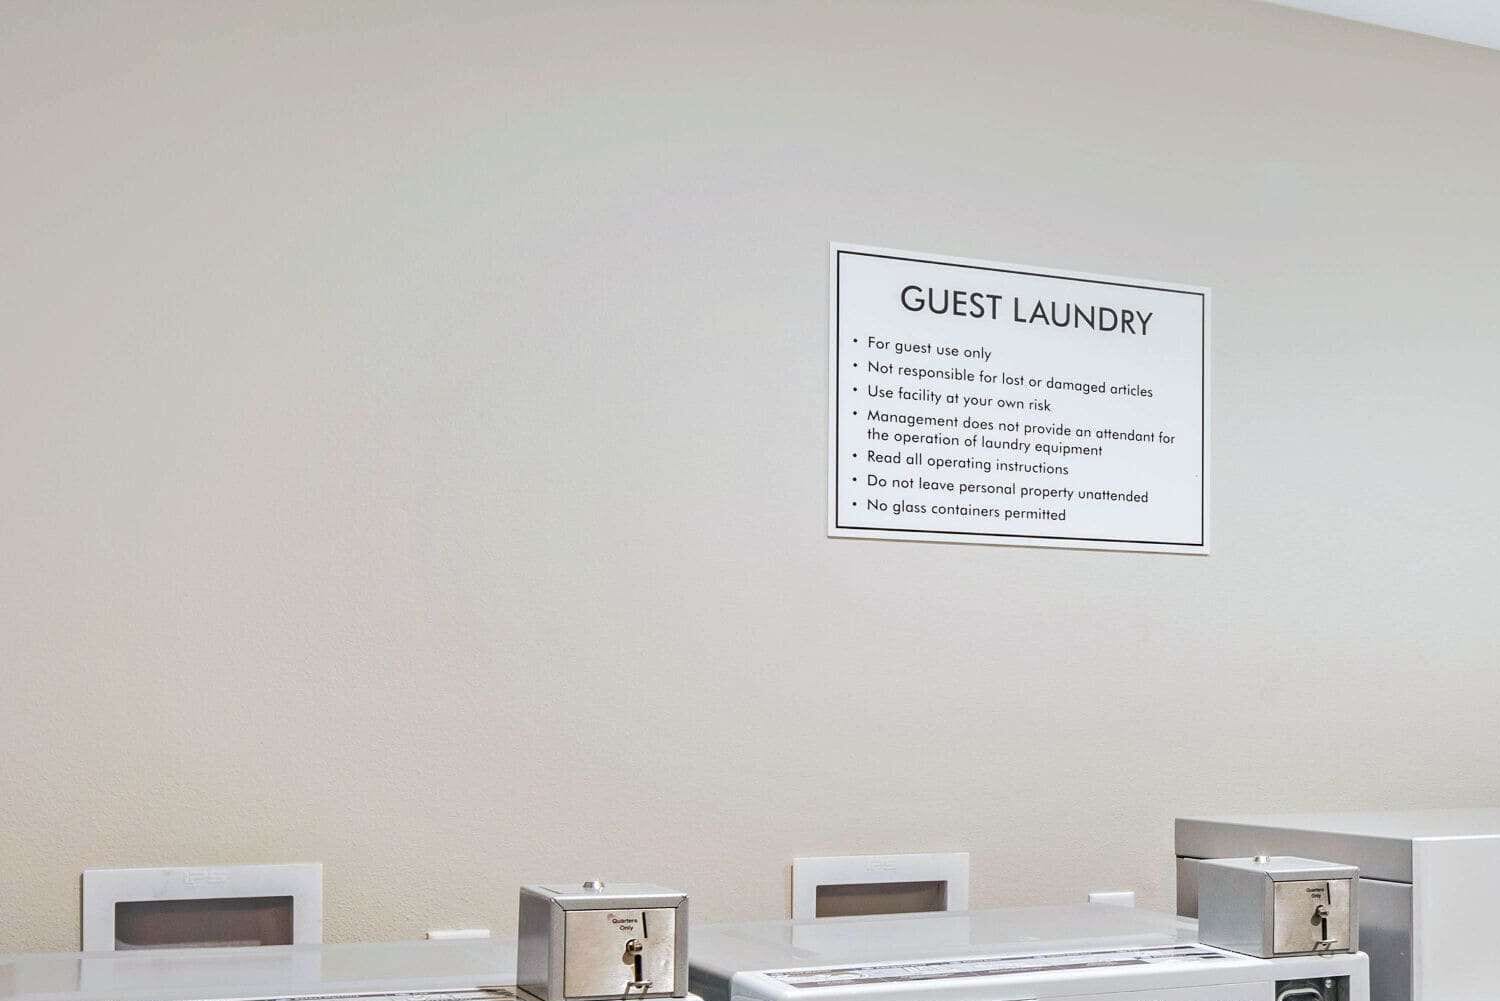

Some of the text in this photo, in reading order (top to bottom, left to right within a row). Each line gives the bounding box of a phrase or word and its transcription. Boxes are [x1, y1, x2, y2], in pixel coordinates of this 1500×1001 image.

[900, 284, 1153, 336] GUEST LAUNDRY
[868, 335, 992, 362] For guest use only
[868, 360, 1153, 398] Not responsible for lost or damaged articles
[868, 384, 1051, 412] Use facility at your own risk
[867, 409, 1175, 444] Management does not provide an attendant for
[867, 427, 1102, 456] the operation of laundry equipment
[867, 449, 1069, 475] Read all operating instructions
[867, 474, 1148, 503] Do not leave personal property unattended
[867, 498, 1066, 521] No glass containers permitted
